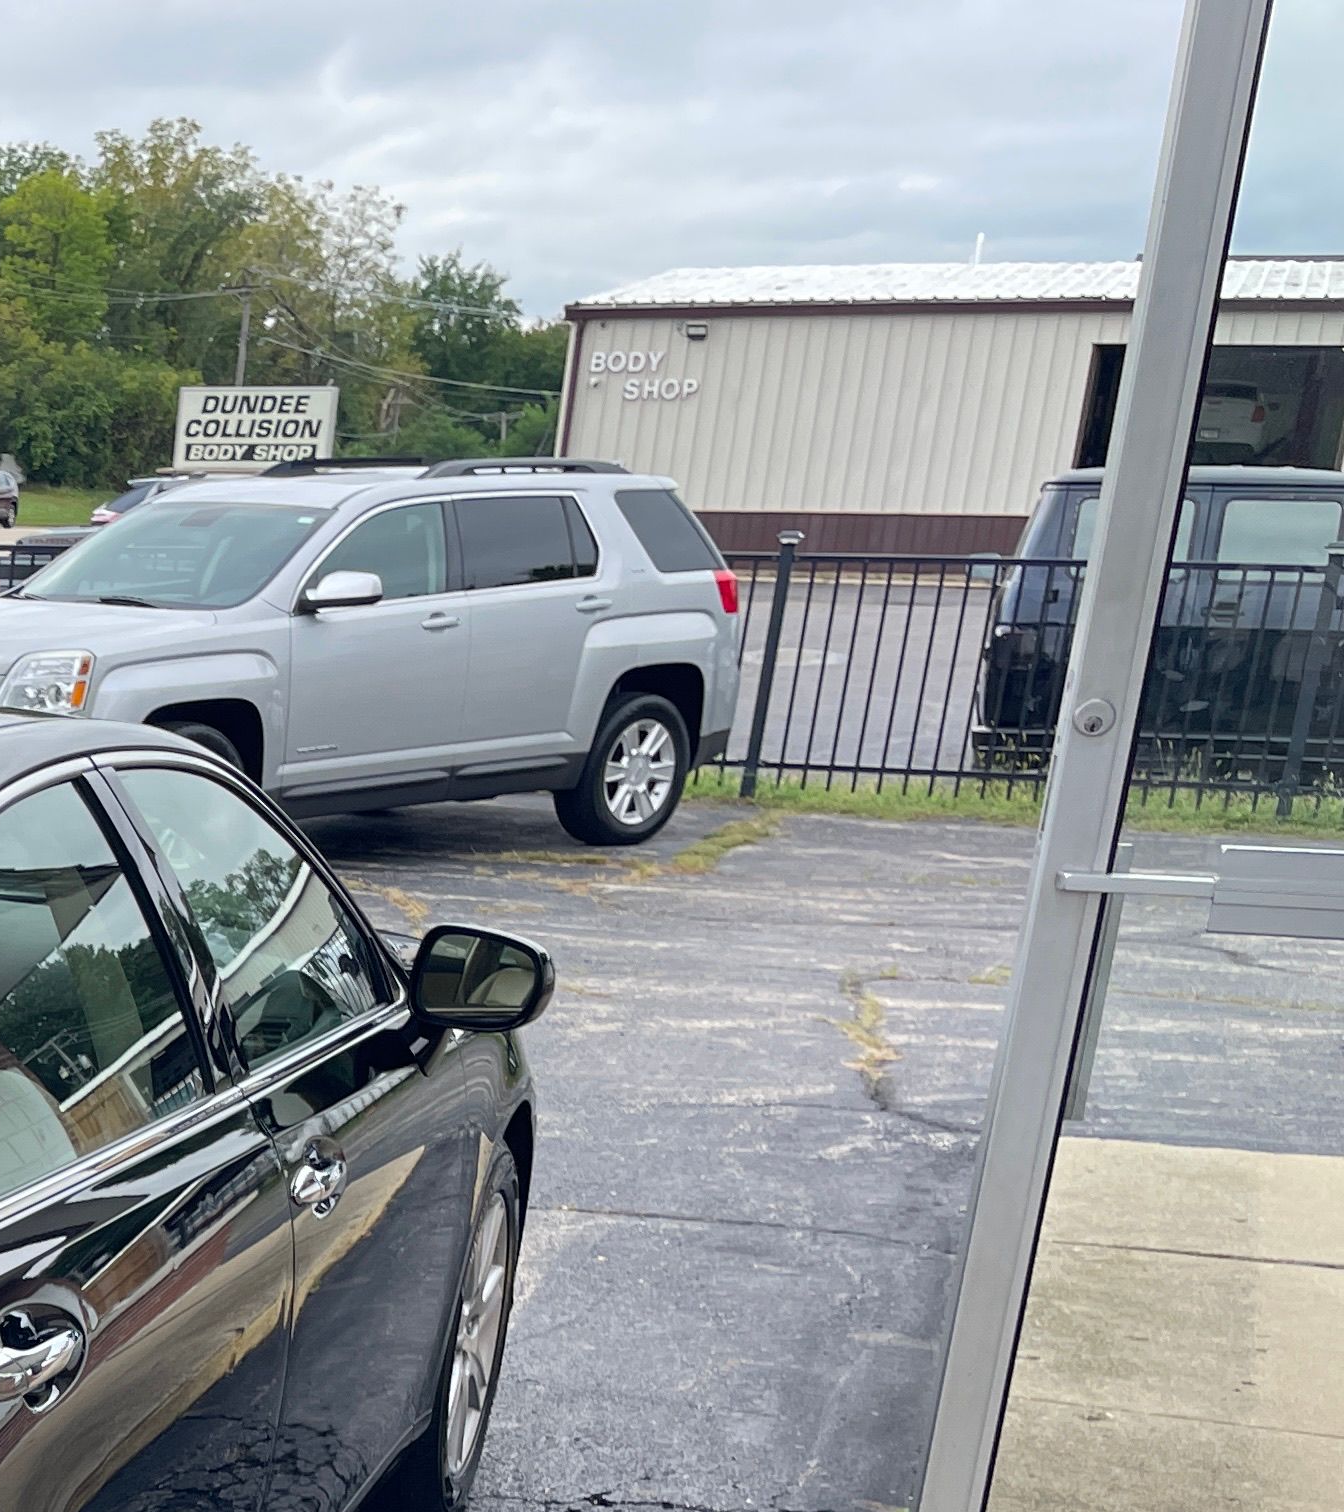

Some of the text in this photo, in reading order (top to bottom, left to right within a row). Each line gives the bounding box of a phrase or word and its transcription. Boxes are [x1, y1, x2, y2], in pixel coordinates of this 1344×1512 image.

[590, 351, 665, 373] BODY
[623, 378, 698, 400] SHOP
[201, 395, 310, 414] DUNDEE
[185, 419, 322, 438] COLLISION
[188, 445, 313, 461] BODY SHOP
